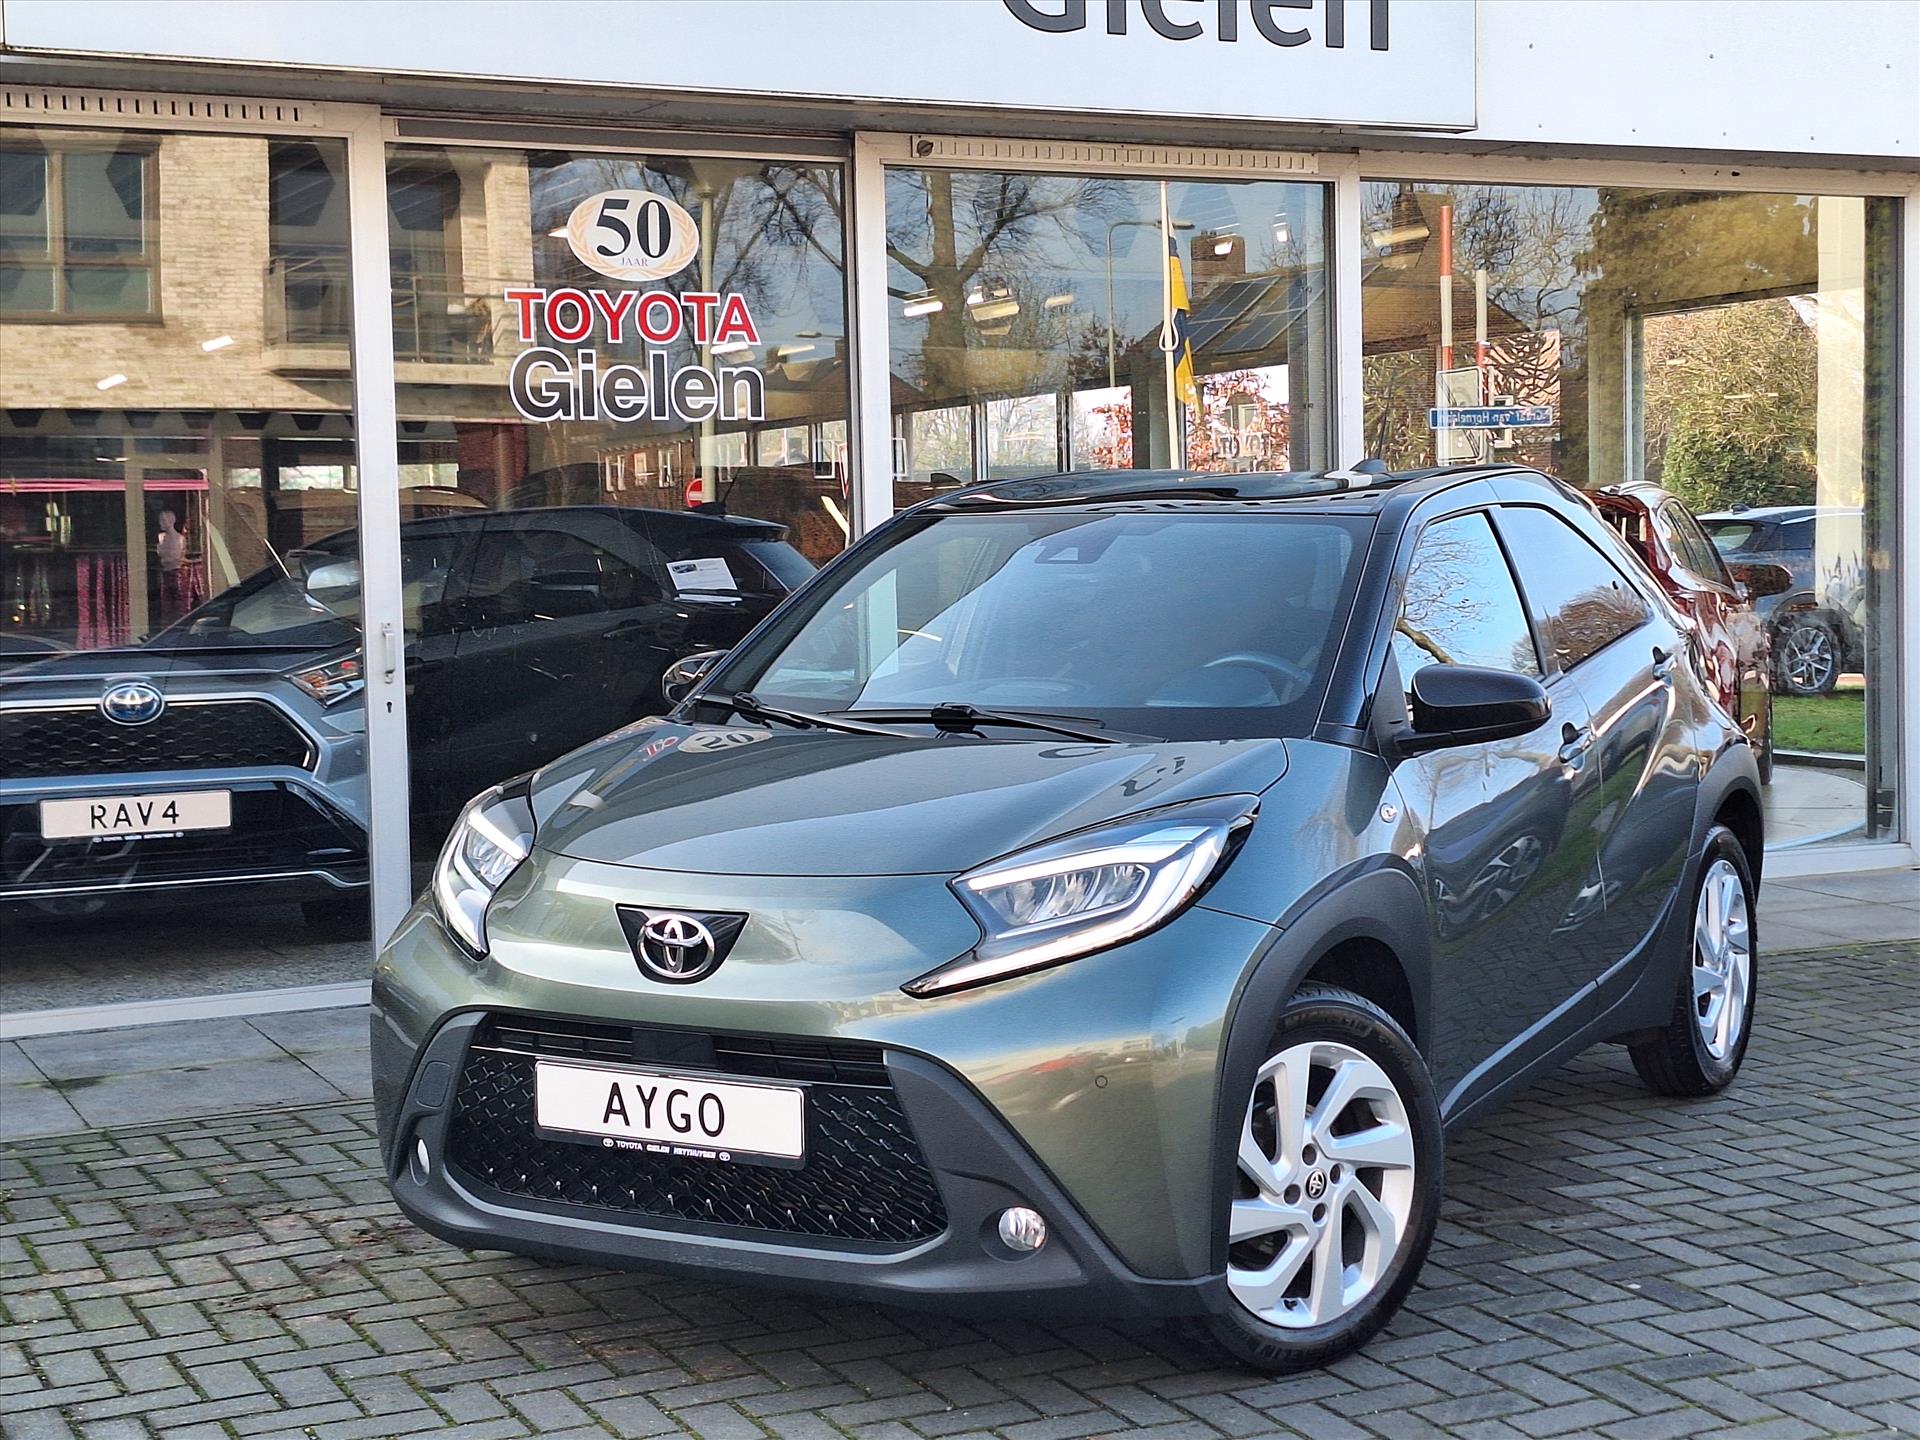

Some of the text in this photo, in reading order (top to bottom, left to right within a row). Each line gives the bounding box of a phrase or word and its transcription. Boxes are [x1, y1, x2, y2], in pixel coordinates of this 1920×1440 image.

[596, 198, 672, 258] 50
[620, 257, 649, 268] JAAR
[504, 287, 762, 346] TOYOTA
[509, 346, 766, 423] Gielen
[602, 1081, 725, 1138] AYGO
[615, 1140, 643, 1151] TOYOTA
